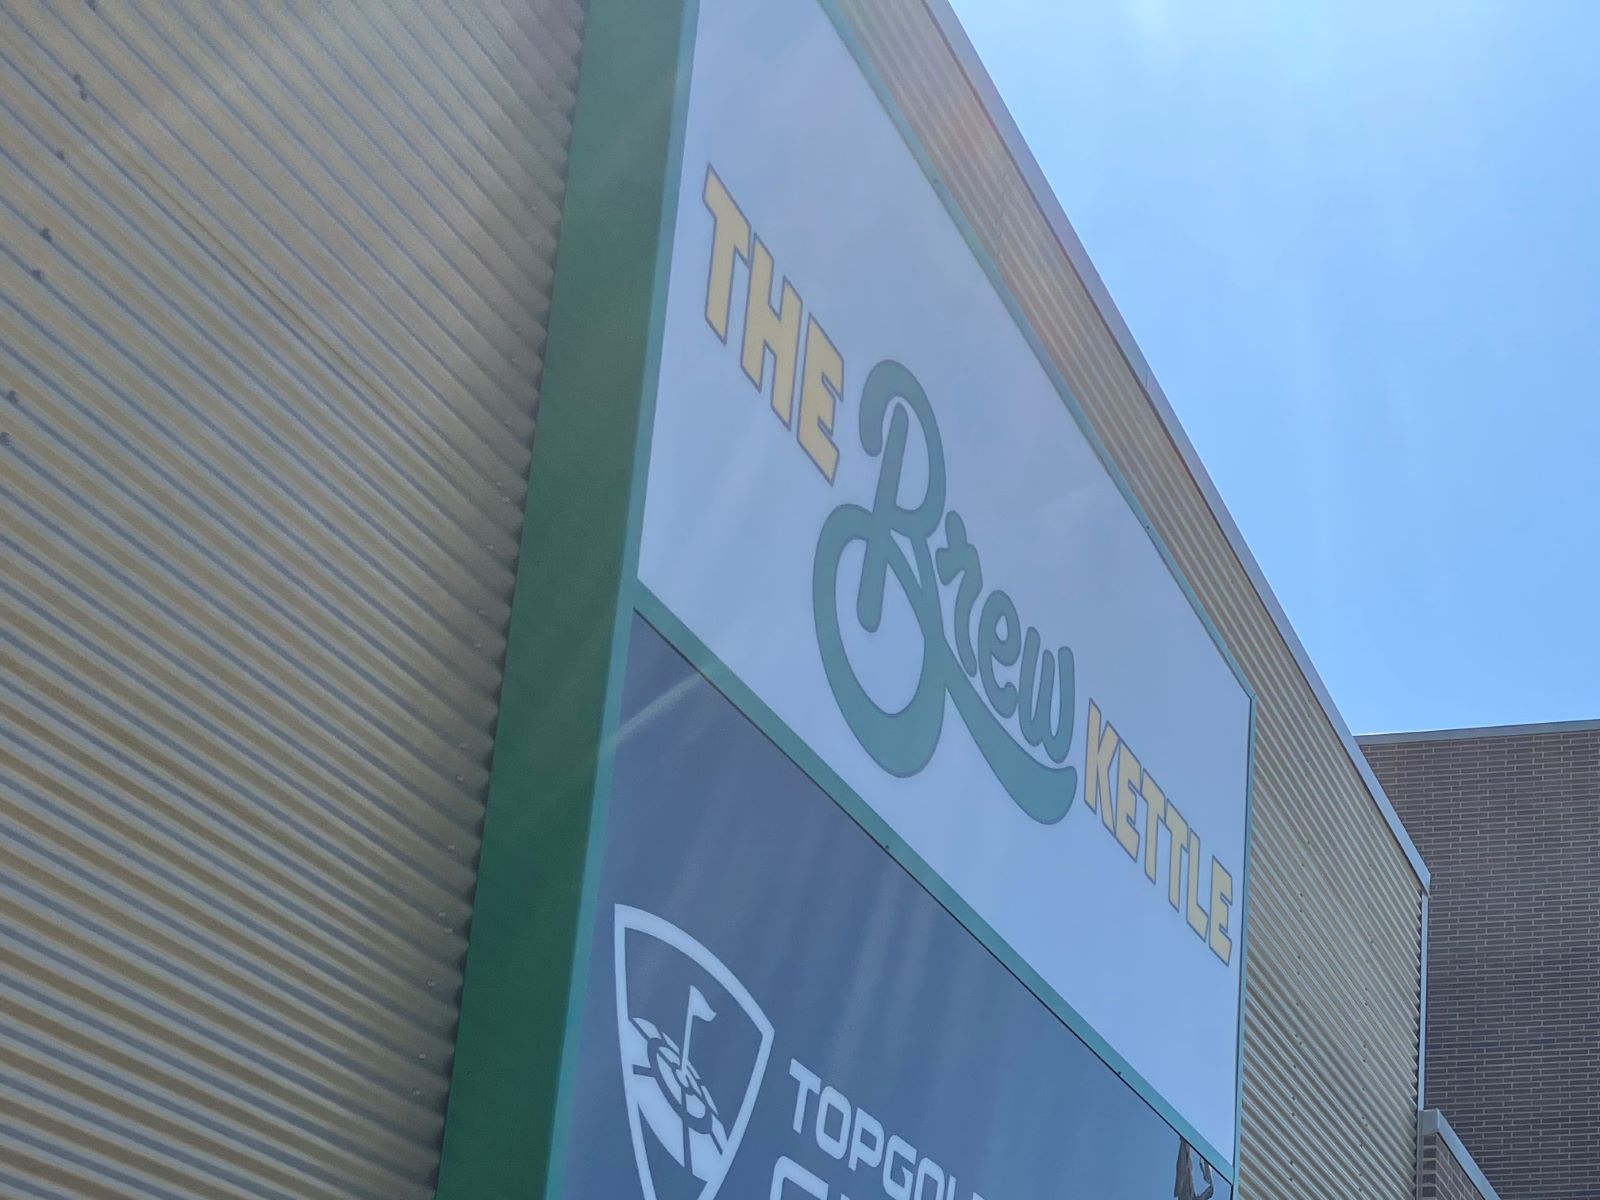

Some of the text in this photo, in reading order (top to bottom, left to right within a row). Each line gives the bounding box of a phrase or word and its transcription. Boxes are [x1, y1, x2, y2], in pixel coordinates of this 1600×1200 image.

[702, 163, 1234, 966] THE Brew KETTLE
